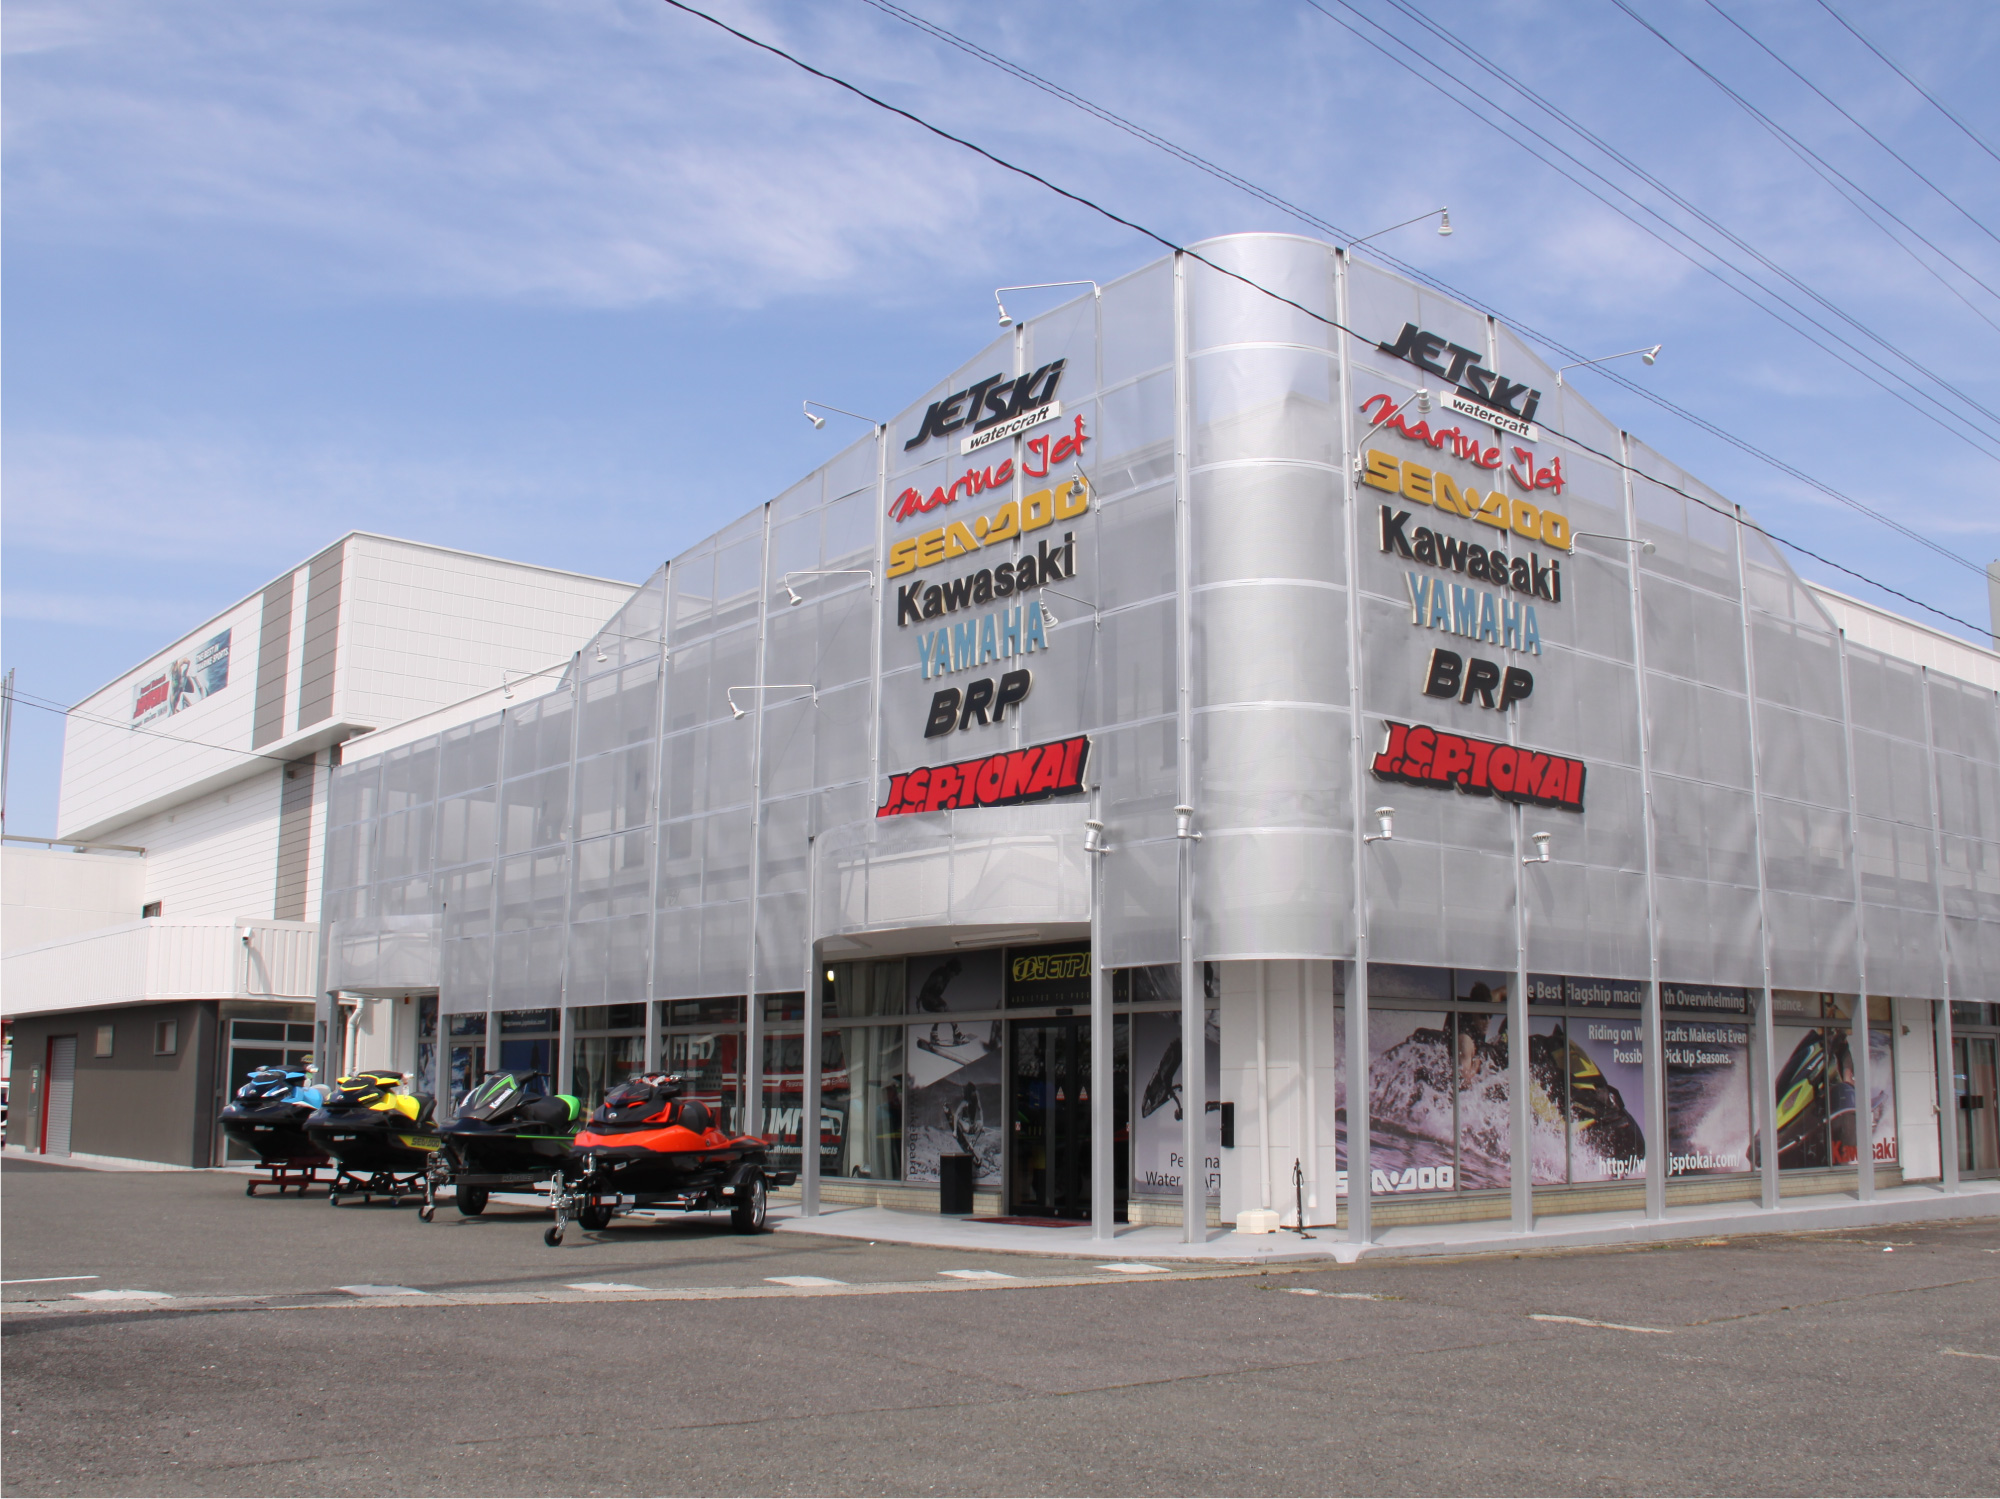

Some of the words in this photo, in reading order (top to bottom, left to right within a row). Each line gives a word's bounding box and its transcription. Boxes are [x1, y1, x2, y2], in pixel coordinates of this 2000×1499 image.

[969, 406, 1050, 449] watercraft
[1360, 394, 1503, 470] Marine
[1508, 446, 1566, 495] Jet
[1453, 399, 1529, 436] watercraft
[888, 458, 1014, 522] Marine
[1022, 414, 1090, 477] Jet
[898, 531, 1076, 626] Kawasaki
[1379, 505, 1561, 602] Kawasaki
[917, 601, 1048, 680] YAMAHA
[1405, 571, 1542, 655] YAMAHA
[924, 669, 1033, 738] BRP
[1422, 647, 1534, 712] BRP
[1537, 981, 1562, 999] Best
[1677, 992, 1745, 1013] Overwhelming
[1589, 1025, 1619, 1044] Riding
[1621, 1030, 1632, 1041] on
[1689, 1028, 1715, 1042] Makes
[1717, 1030, 1727, 1043] Us
[1728, 1031, 1747, 1044] Even
[1683, 1049, 1694, 1067] Up
[1696, 1049, 1731, 1065] Seasons.
